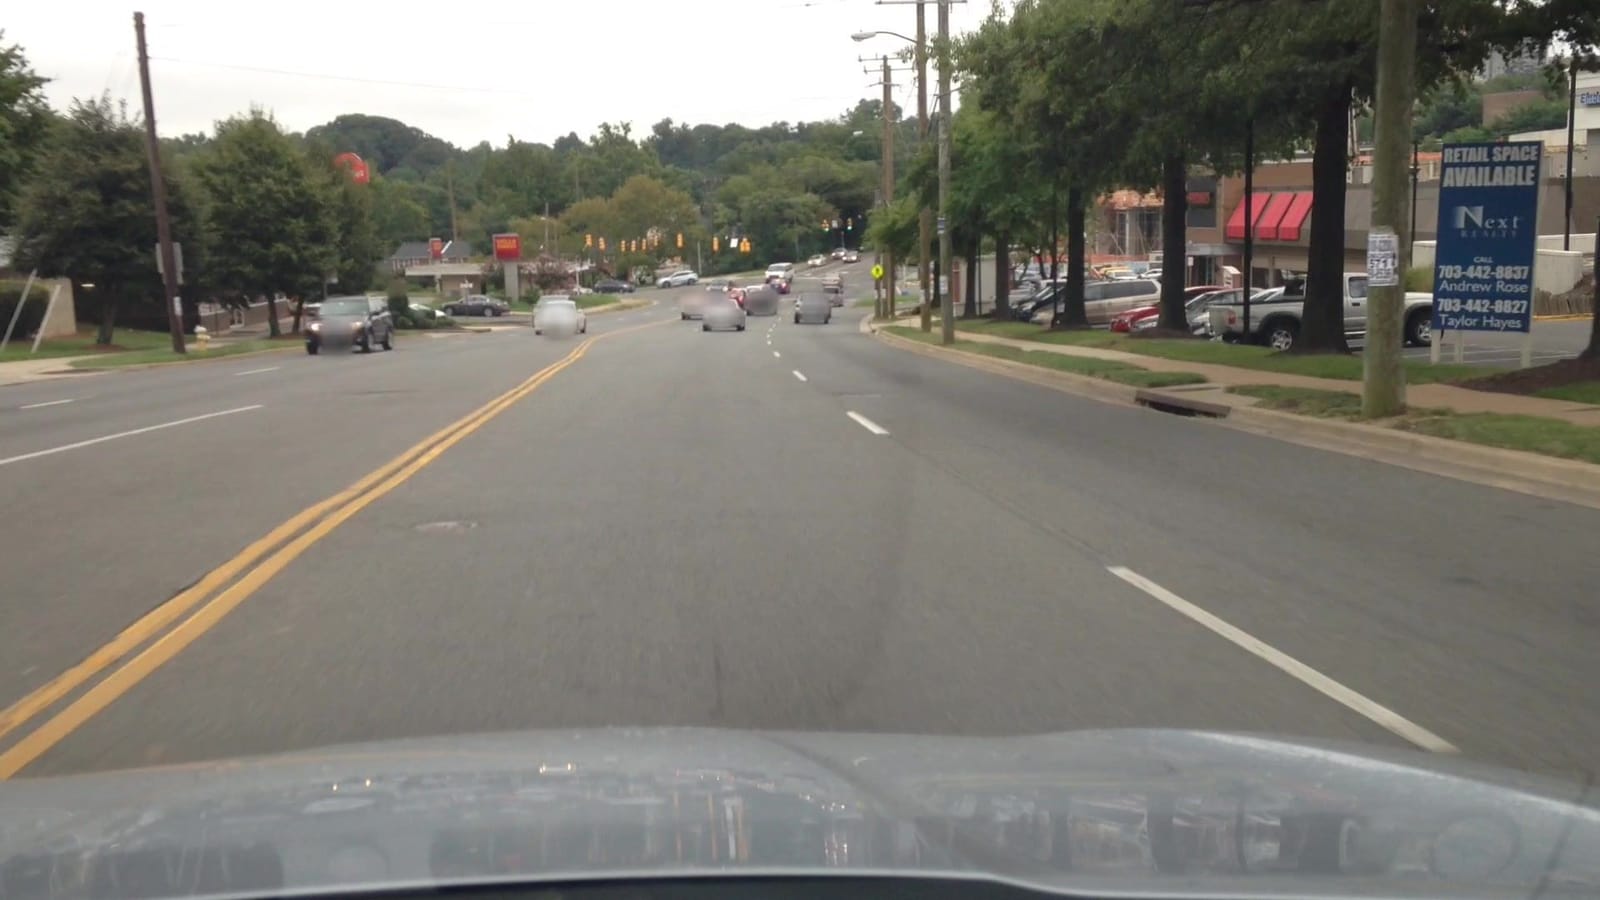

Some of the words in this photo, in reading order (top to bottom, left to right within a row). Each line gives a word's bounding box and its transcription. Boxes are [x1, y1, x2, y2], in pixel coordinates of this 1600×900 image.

[1443, 147, 1490, 163] RETAIL
[1492, 145, 1539, 161] SPACE
[1442, 165, 1536, 187] AVAILABLE
[1454, 205, 1519, 229] Next
[1438, 265, 1529, 280] 703-442-8837
[1438, 280, 1493, 292] Andrew
[1496, 281, 1529, 293] Rose
[1437, 298, 1528, 314] 703-442-8827
[1438, 313, 1478, 329] Taylor
[1482, 315, 1522, 330] Hayes
